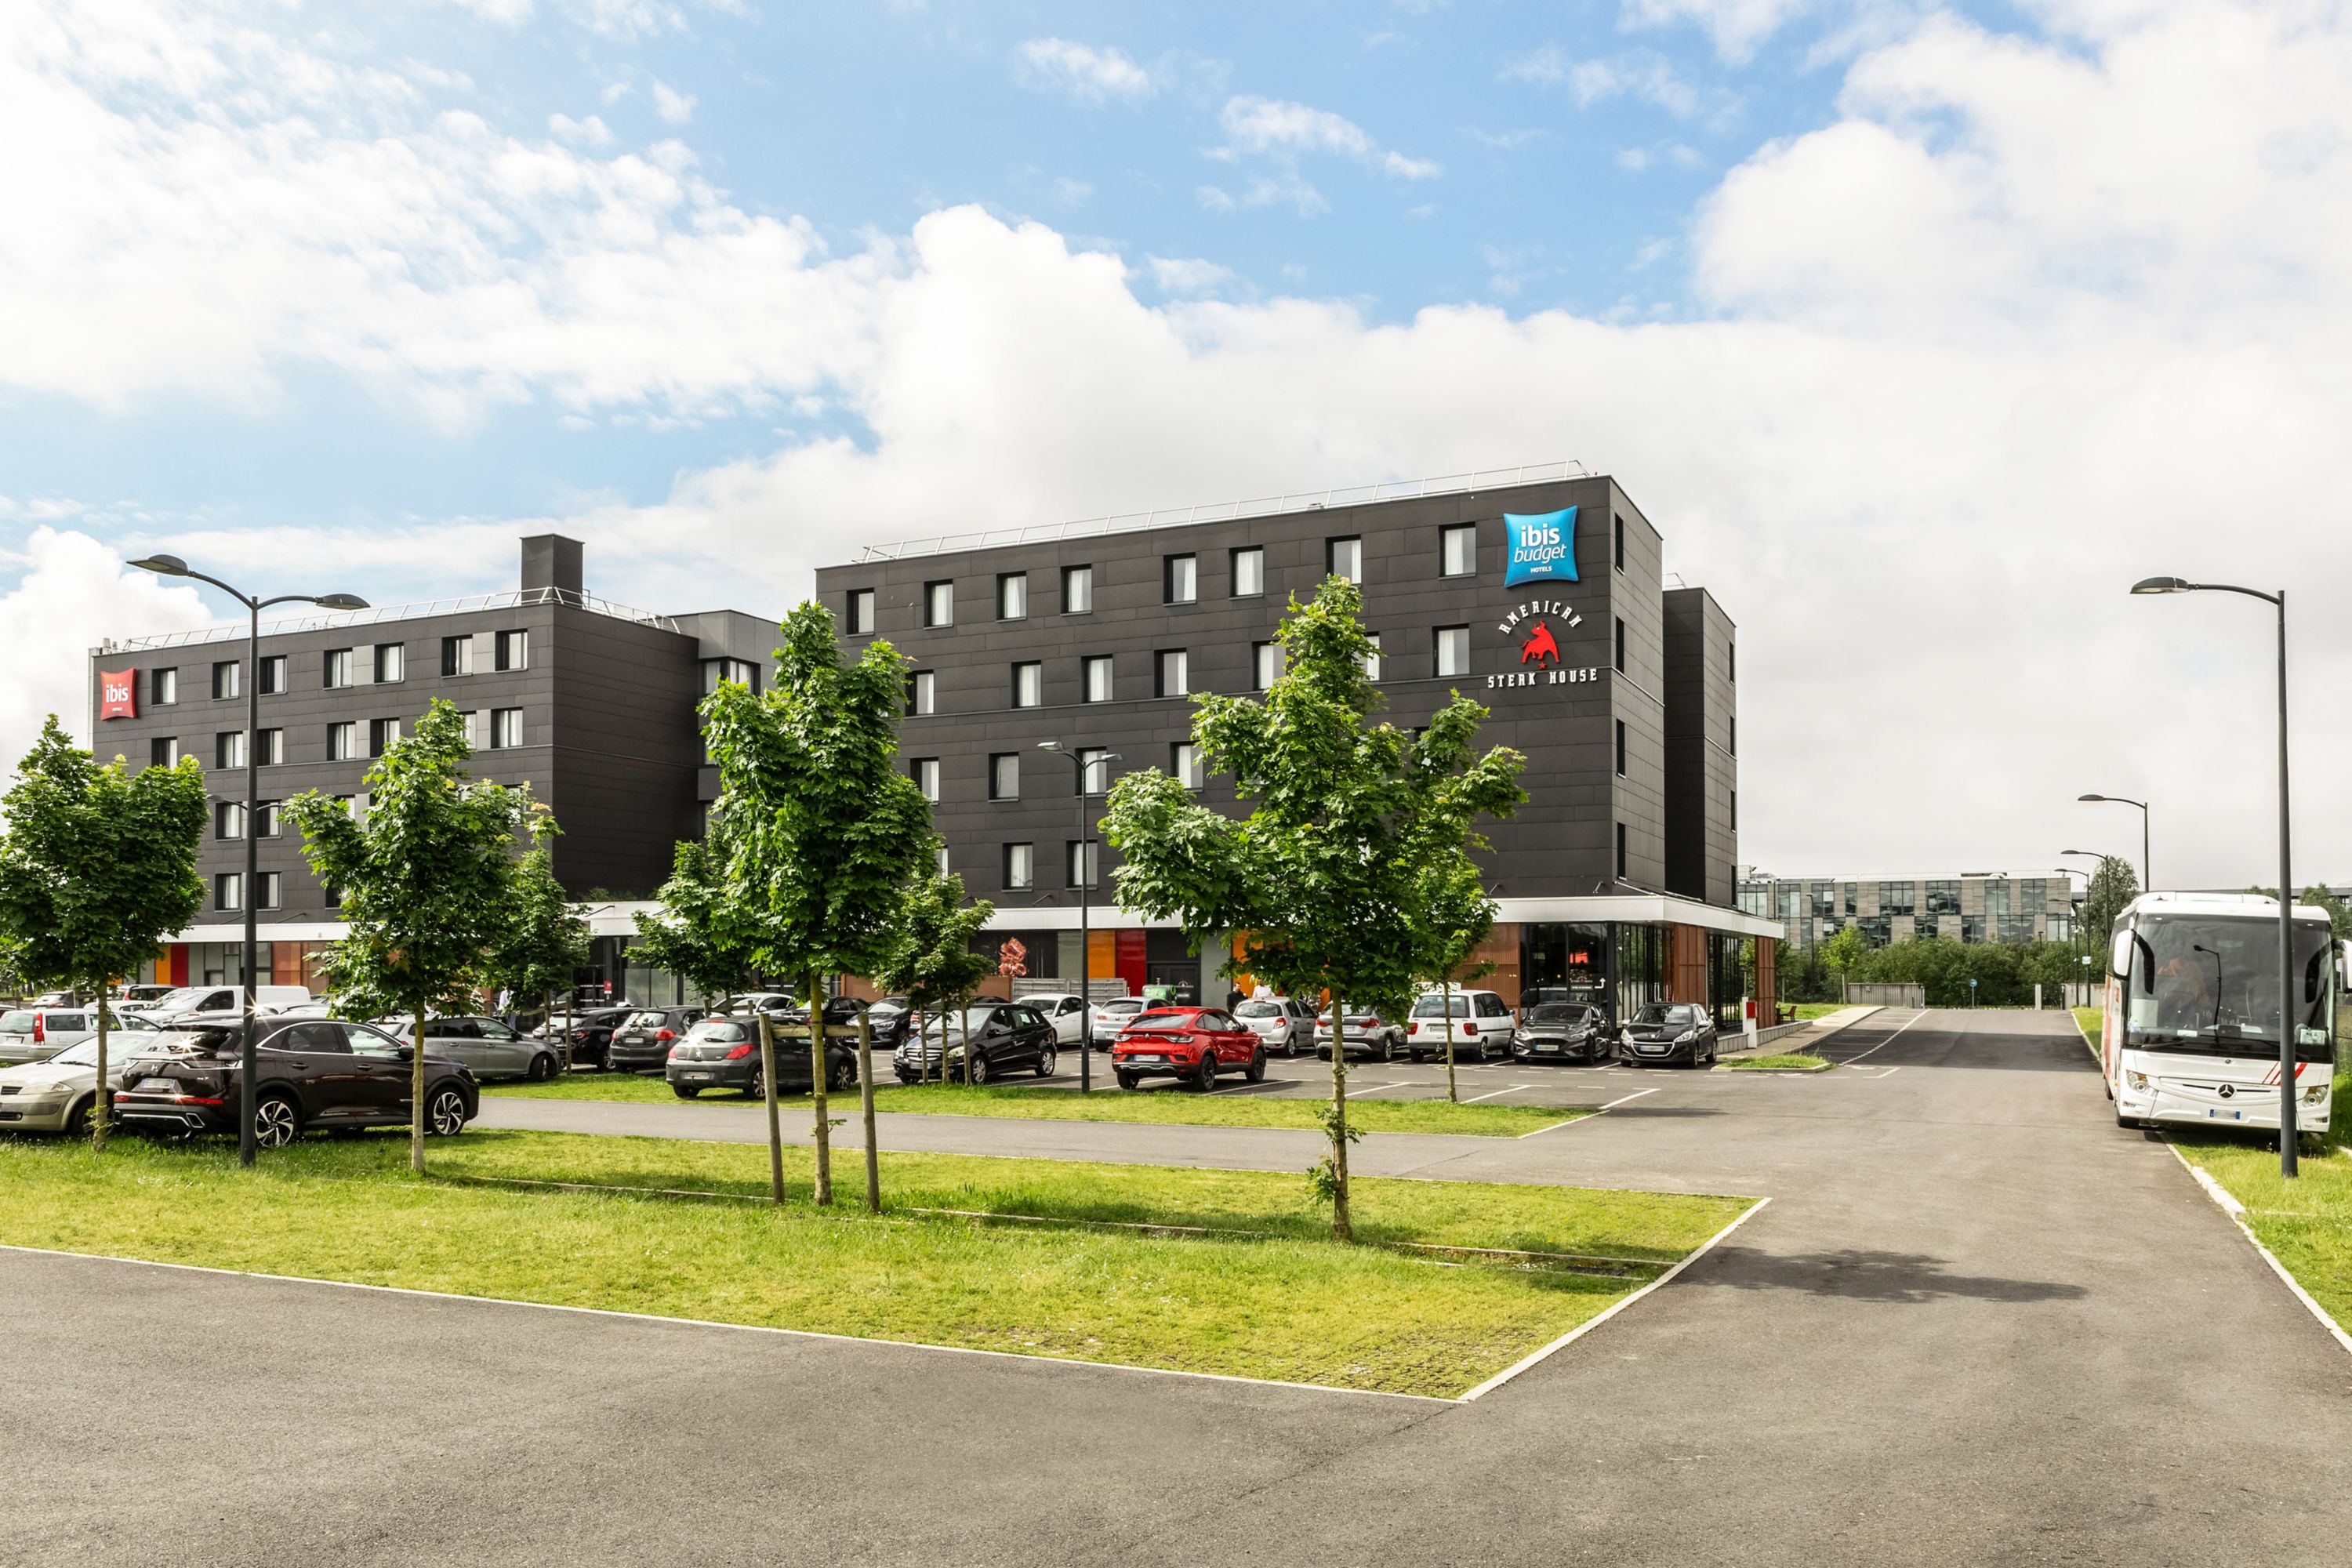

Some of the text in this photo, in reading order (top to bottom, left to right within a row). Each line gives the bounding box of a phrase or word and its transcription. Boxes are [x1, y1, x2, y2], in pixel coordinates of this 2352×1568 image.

[1521, 523, 1561, 547] ibis
[1514, 543, 1567, 564] budget
[1498, 600, 1582, 635] AMERICAN
[1487, 668, 1598, 688] STEAK HOUSE
[105, 683, 129, 703] ibis
